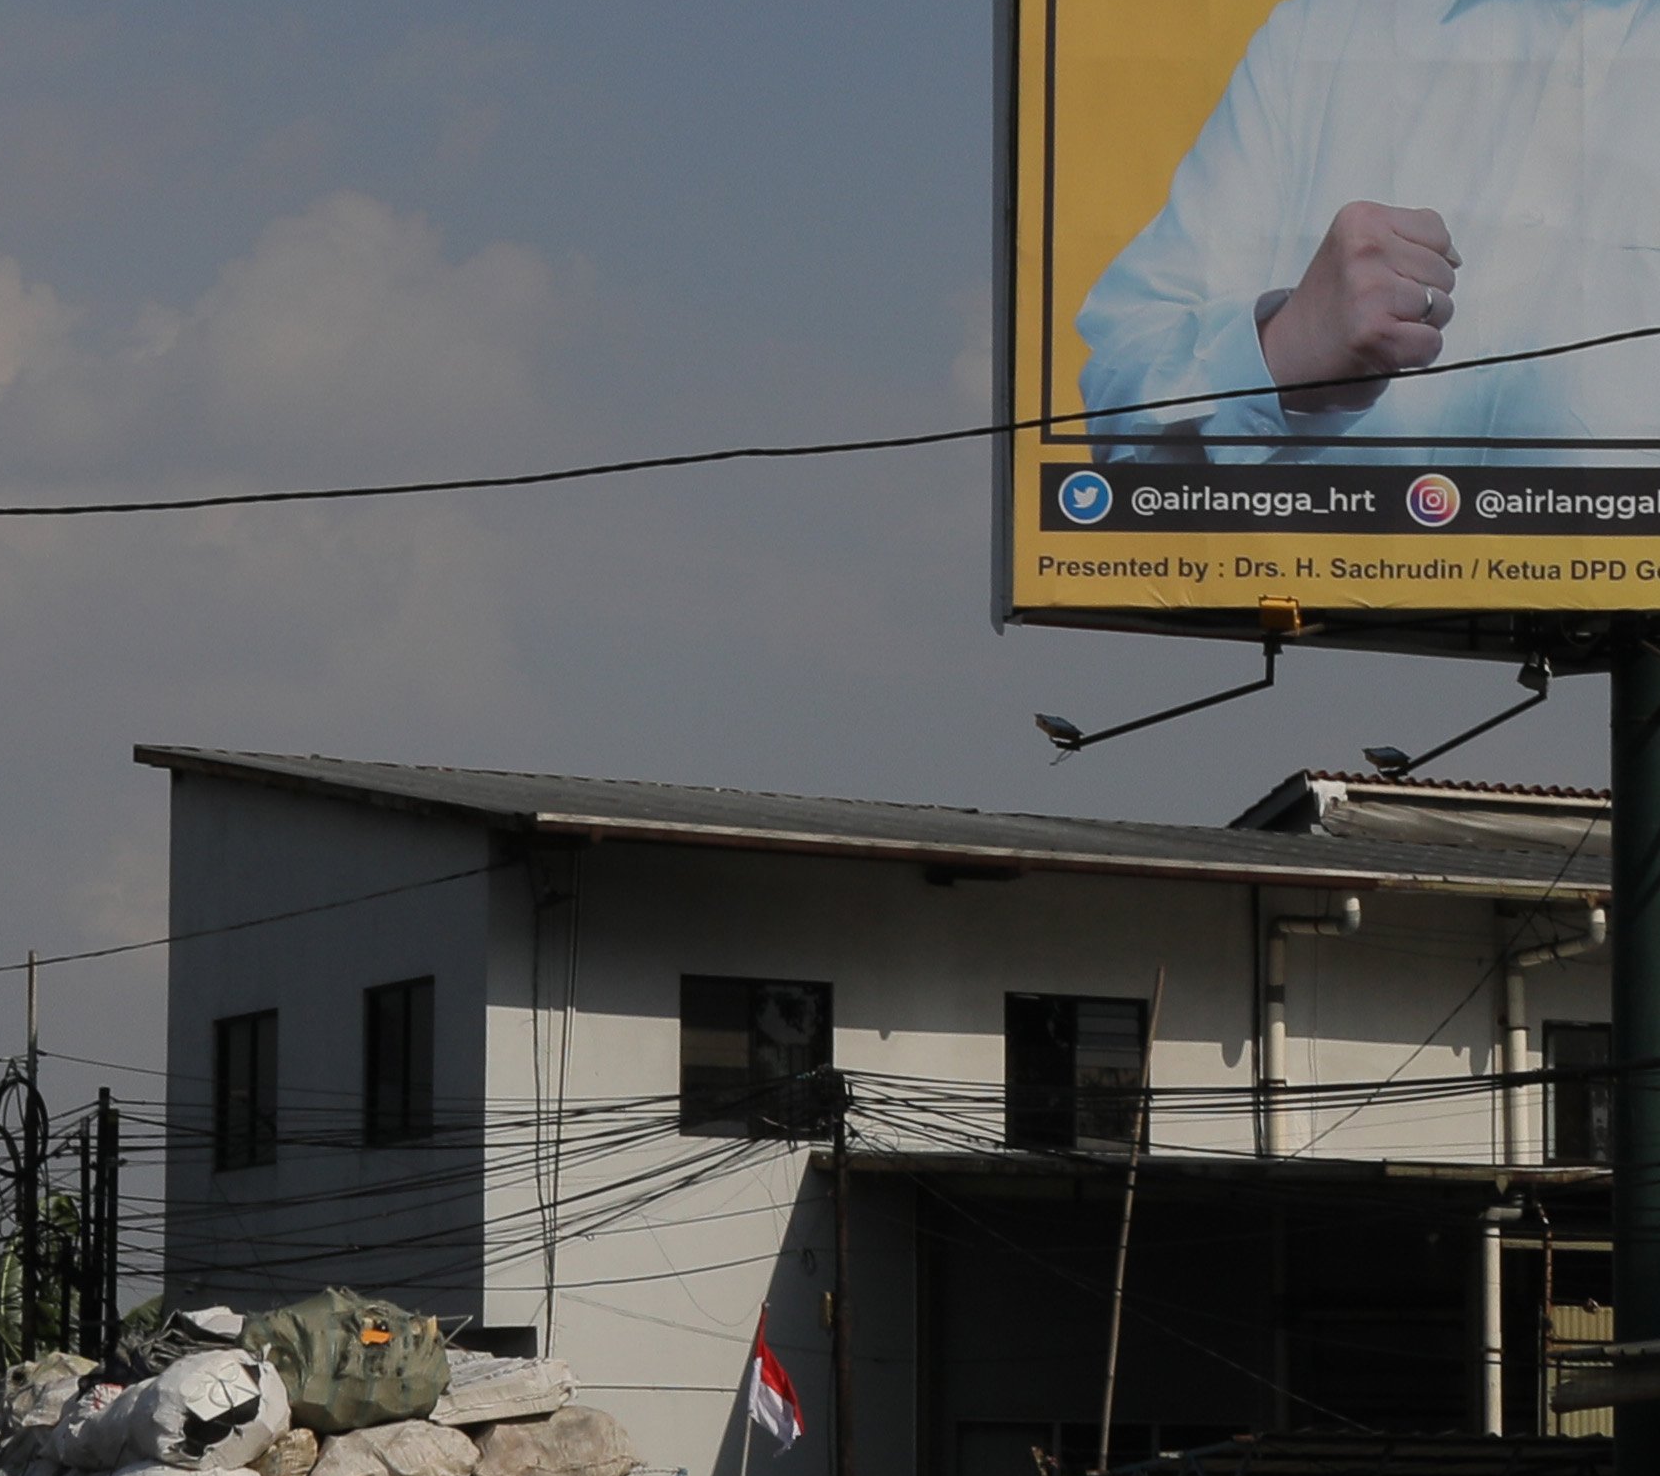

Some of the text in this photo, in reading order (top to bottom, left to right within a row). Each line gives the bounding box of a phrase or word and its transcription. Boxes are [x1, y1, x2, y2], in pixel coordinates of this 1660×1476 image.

[1131, 486, 1376, 517] @airlangga_hrt
[1038, 556, 1169, 578] Presented
[1178, 557, 1209, 583] by
[1234, 557, 1286, 578] Drs.
[1296, 558, 1321, 578] H.
[1330, 558, 1464, 580] Sachrudin
[1488, 560, 1561, 581] Ketua
[1571, 561, 1627, 581] DPD
